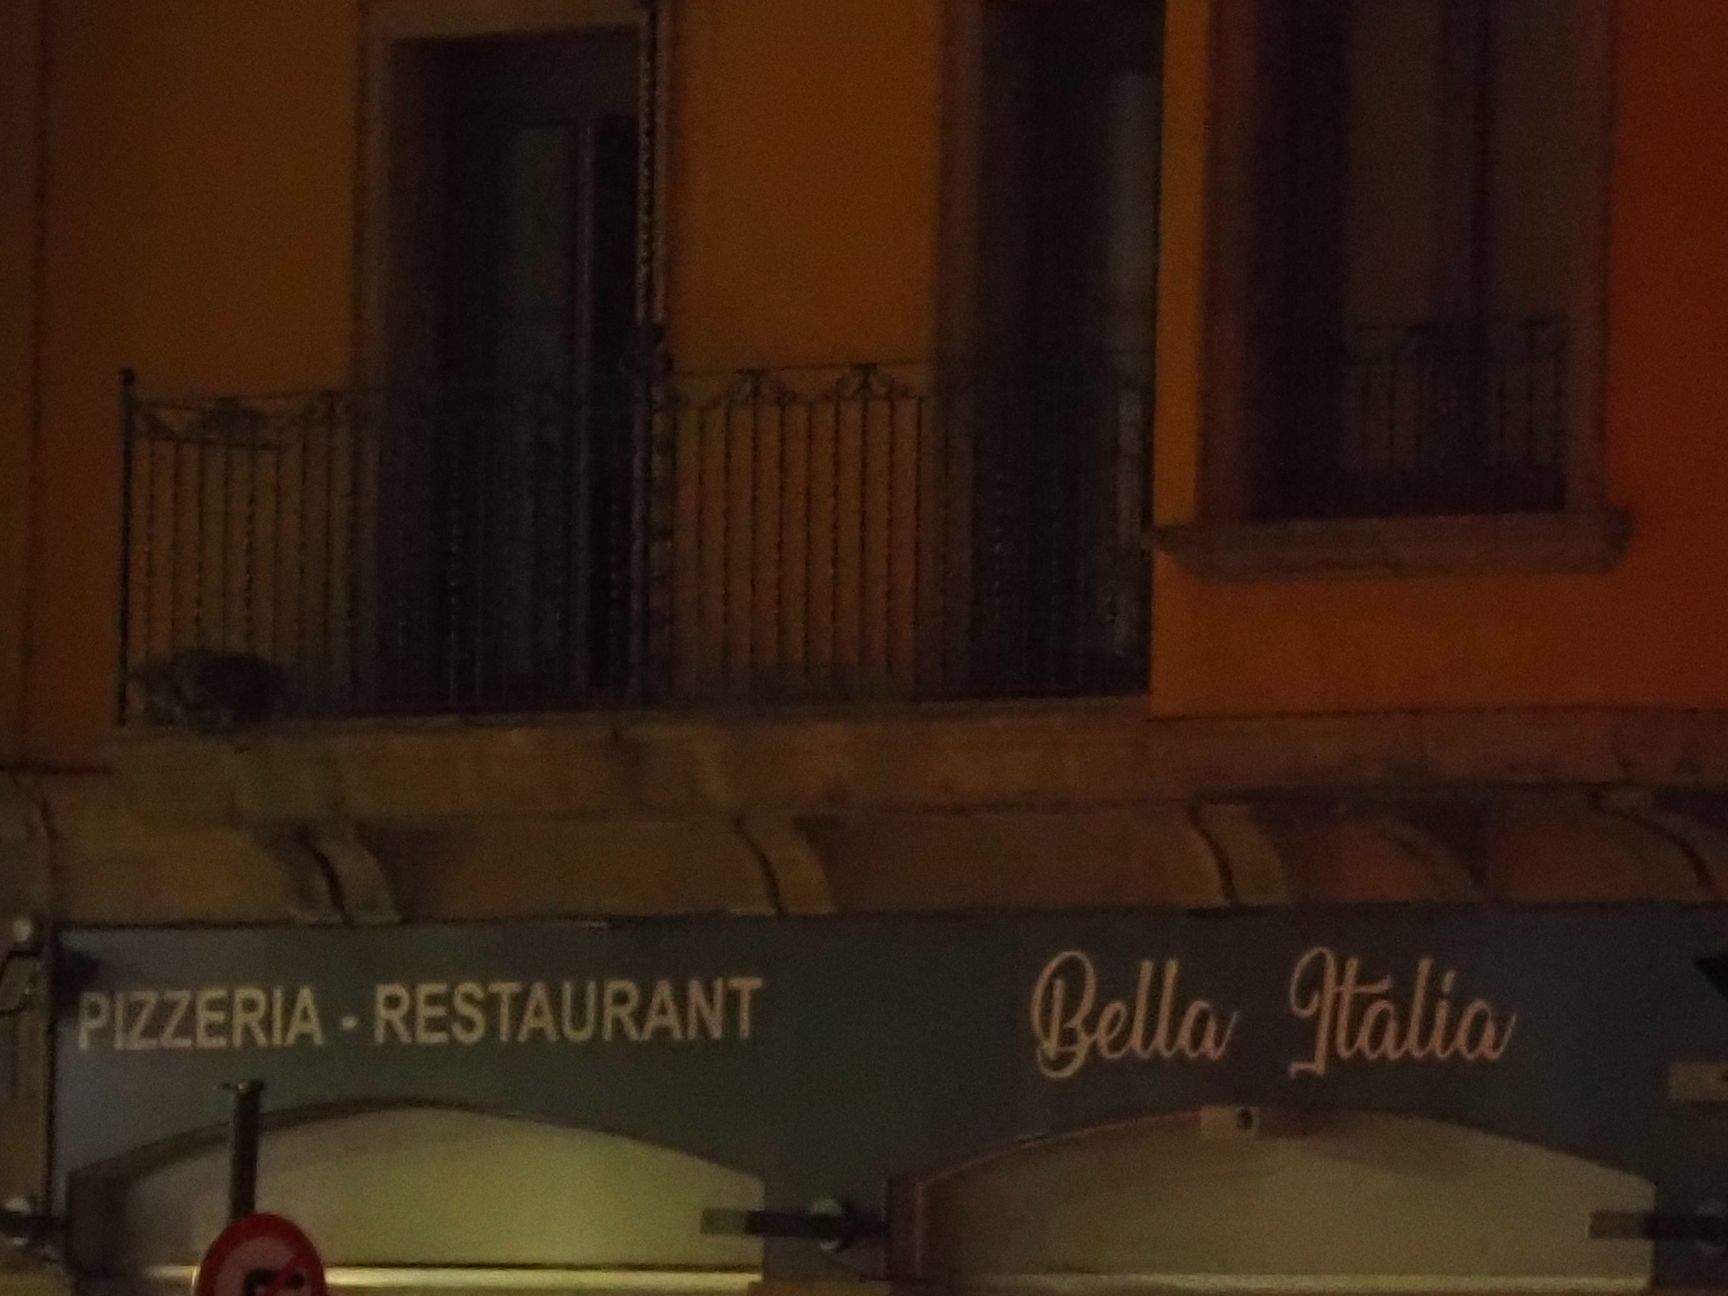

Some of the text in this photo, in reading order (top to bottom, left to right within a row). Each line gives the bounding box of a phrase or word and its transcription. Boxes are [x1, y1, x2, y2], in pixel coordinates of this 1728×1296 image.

[77, 985, 325, 1053] PIZZERIA
[374, 977, 763, 1046] RESTAURANT
[1030, 946, 1517, 1080] Bella Italia
